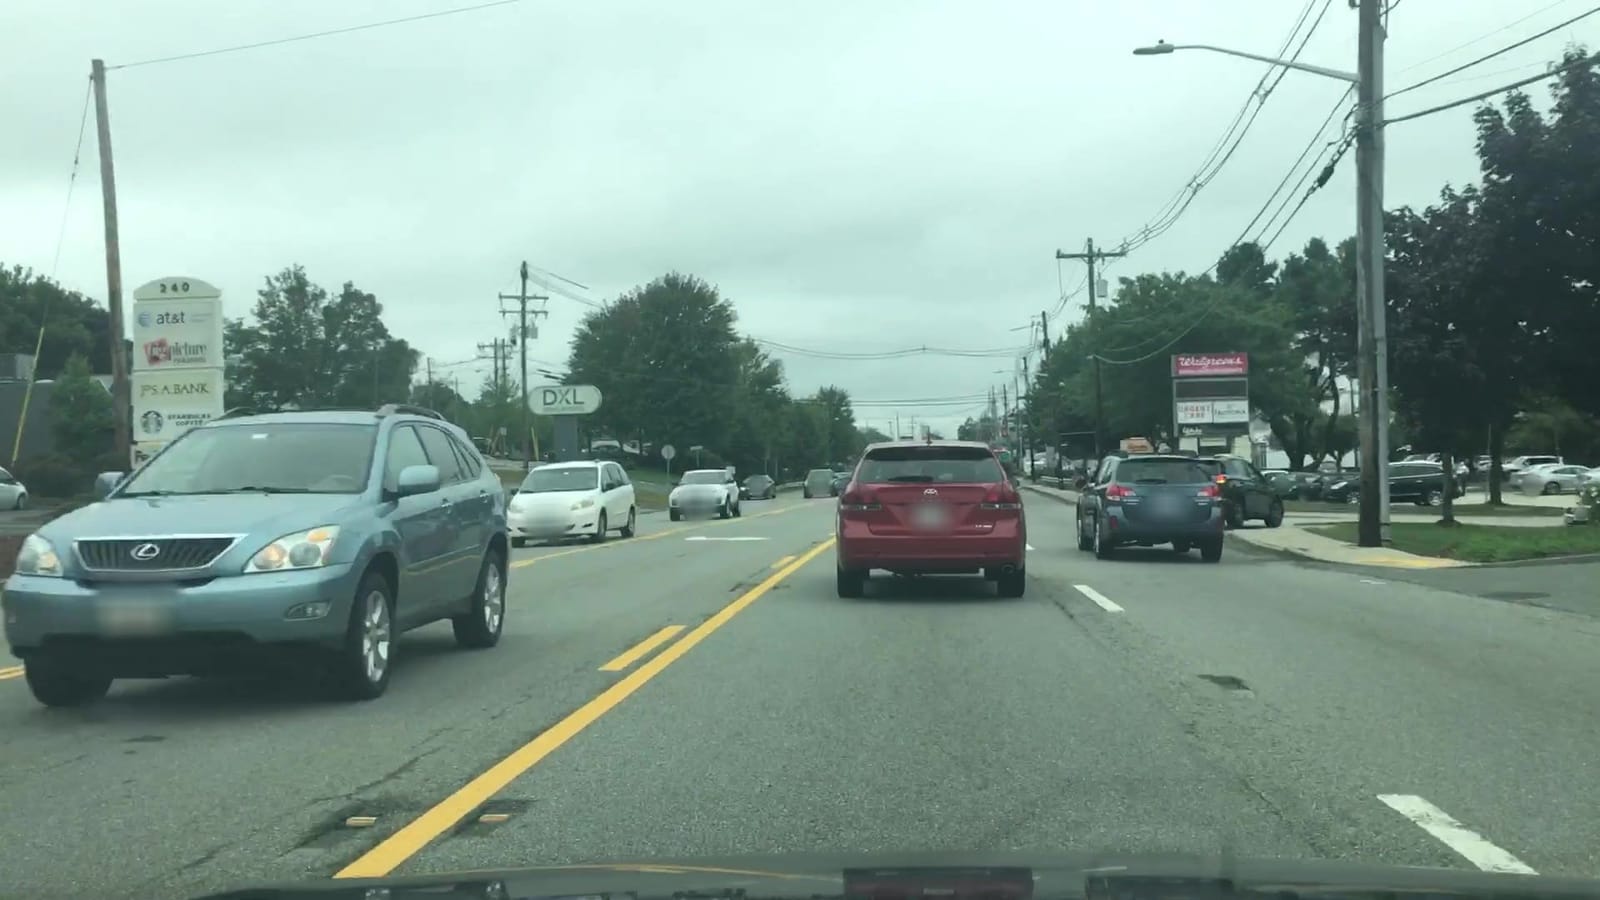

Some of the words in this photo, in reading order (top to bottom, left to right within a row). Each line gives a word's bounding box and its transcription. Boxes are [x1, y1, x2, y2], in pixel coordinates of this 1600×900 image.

[159, 281, 190, 294] 240
[156, 311, 185, 325] at&t
[543, 388, 585, 405] DXL
